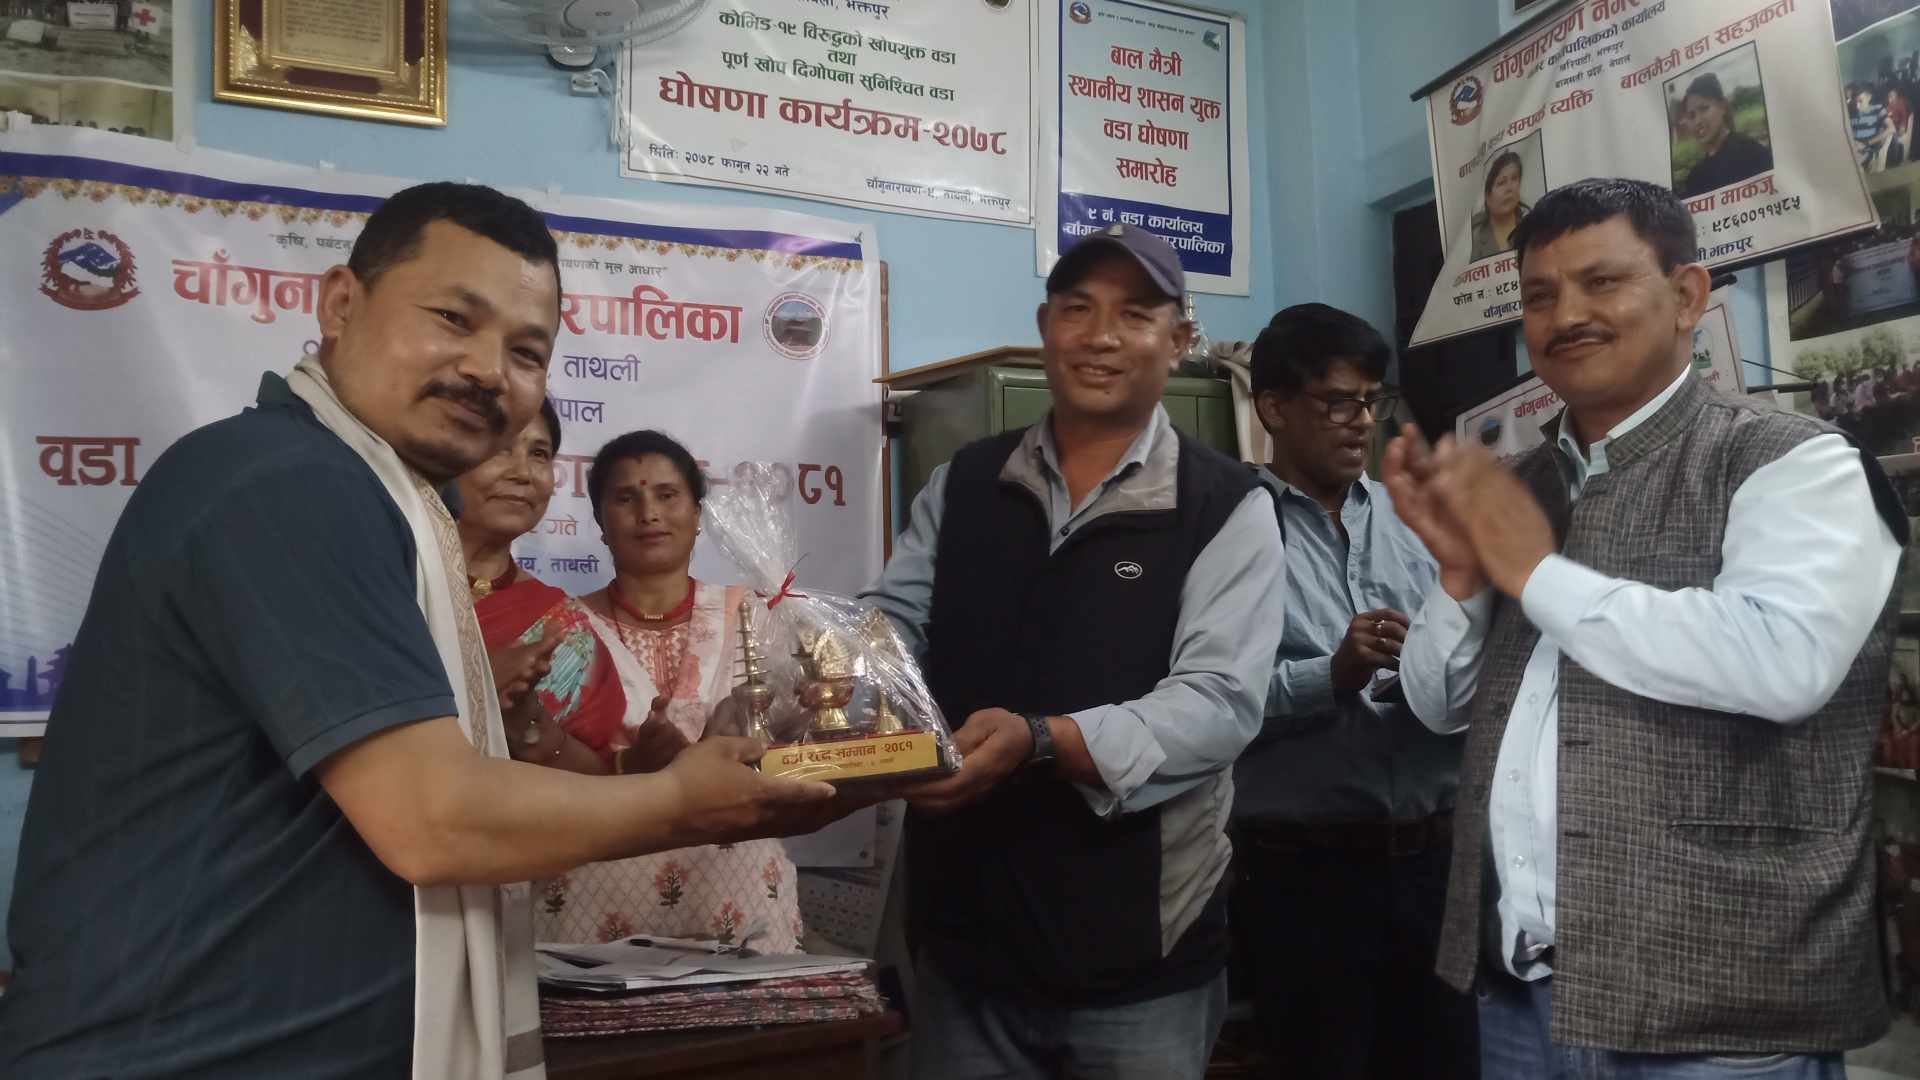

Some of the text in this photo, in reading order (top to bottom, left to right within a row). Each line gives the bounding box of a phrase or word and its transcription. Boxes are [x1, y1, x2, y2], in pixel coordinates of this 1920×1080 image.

[719, 10, 956, 65] कोभिड-१९ विरुद्धको खोपयुक्त वडा
[828, 50, 856, 66] तथा
[1111, 45, 1182, 76] बाल मैत्री
[1620, 48, 1680, 89] बालमैत्री
[1684, 35, 1710, 60] वडा
[721, 49, 955, 102] पूर्ण खोप दिगोपना सुनिश्चित वडा
[1068, 74, 1221, 122] स्थानीय शासन युक्त
[1551, 89, 1595, 115] व्यक्ति
[658, 71, 1008, 156] घोषणा कार्यक्रम-२०७८
[1103, 118, 1189, 150] वडा घोषणा
[685, 151, 716, 165] २०७८
[721, 157, 751, 173] फागुन
[756, 163, 769, 176] २२
[774, 164, 790, 177] गते
[1116, 157, 1178, 187] समारोह
[1120, 211, 1144, 227] वडा
[1148, 215, 1203, 234] कार्यालय
[1709, 236, 1753, 258] भक्तपुर
[604, 261, 623, 275] मूल
[1495, 281, 1518, 296] ९८४
[560, 284, 743, 344] रपालिका
[563, 354, 641, 382] ताथली
[36, 434, 140, 486] वडा
[545, 514, 578, 536] गते
[550, 554, 600, 574] ताथली
